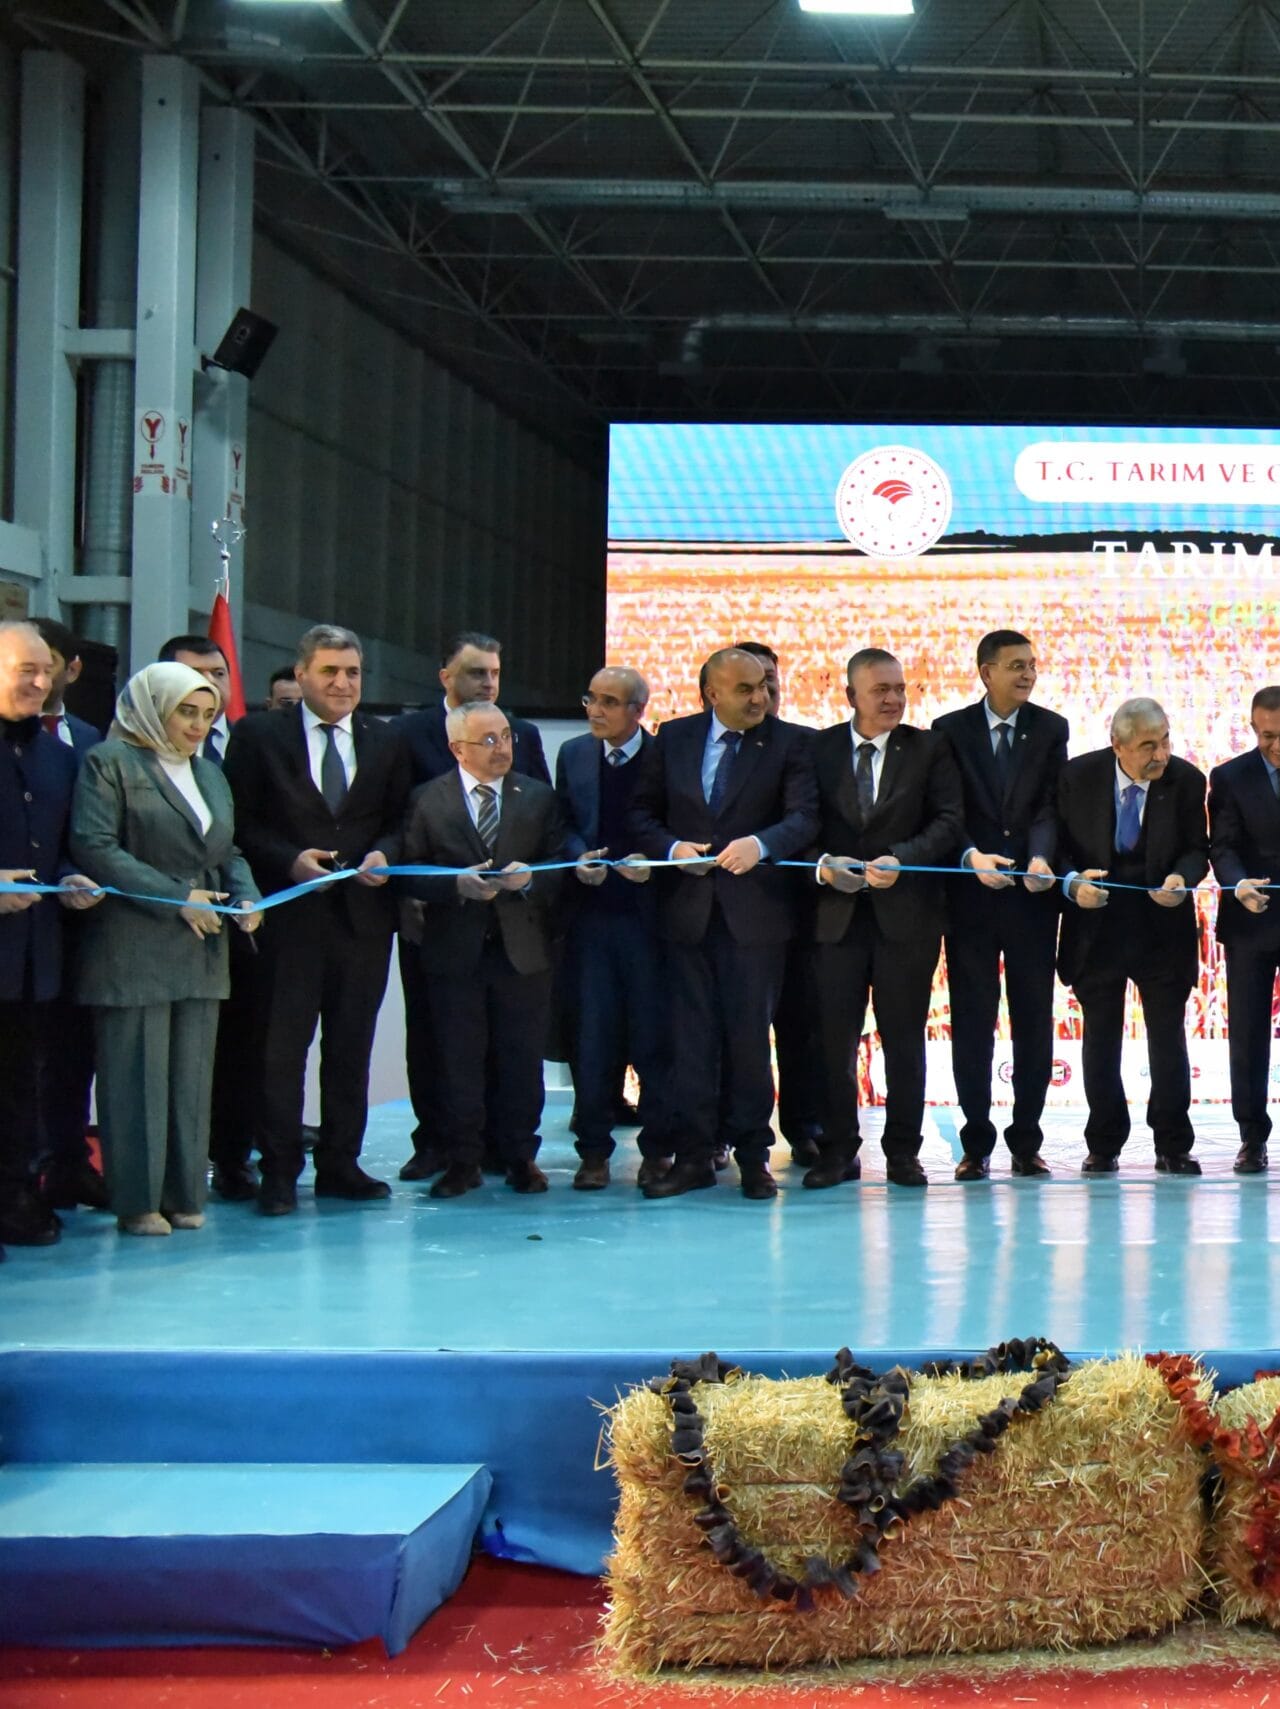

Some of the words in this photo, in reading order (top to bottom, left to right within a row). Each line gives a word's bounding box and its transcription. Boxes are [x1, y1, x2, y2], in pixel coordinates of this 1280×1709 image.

[1035, 461, 1094, 481] T.C.
[1106, 462, 1205, 482] TARIM
[1218, 463, 1255, 483] VE
[1092, 540, 1275, 578] TARIM
